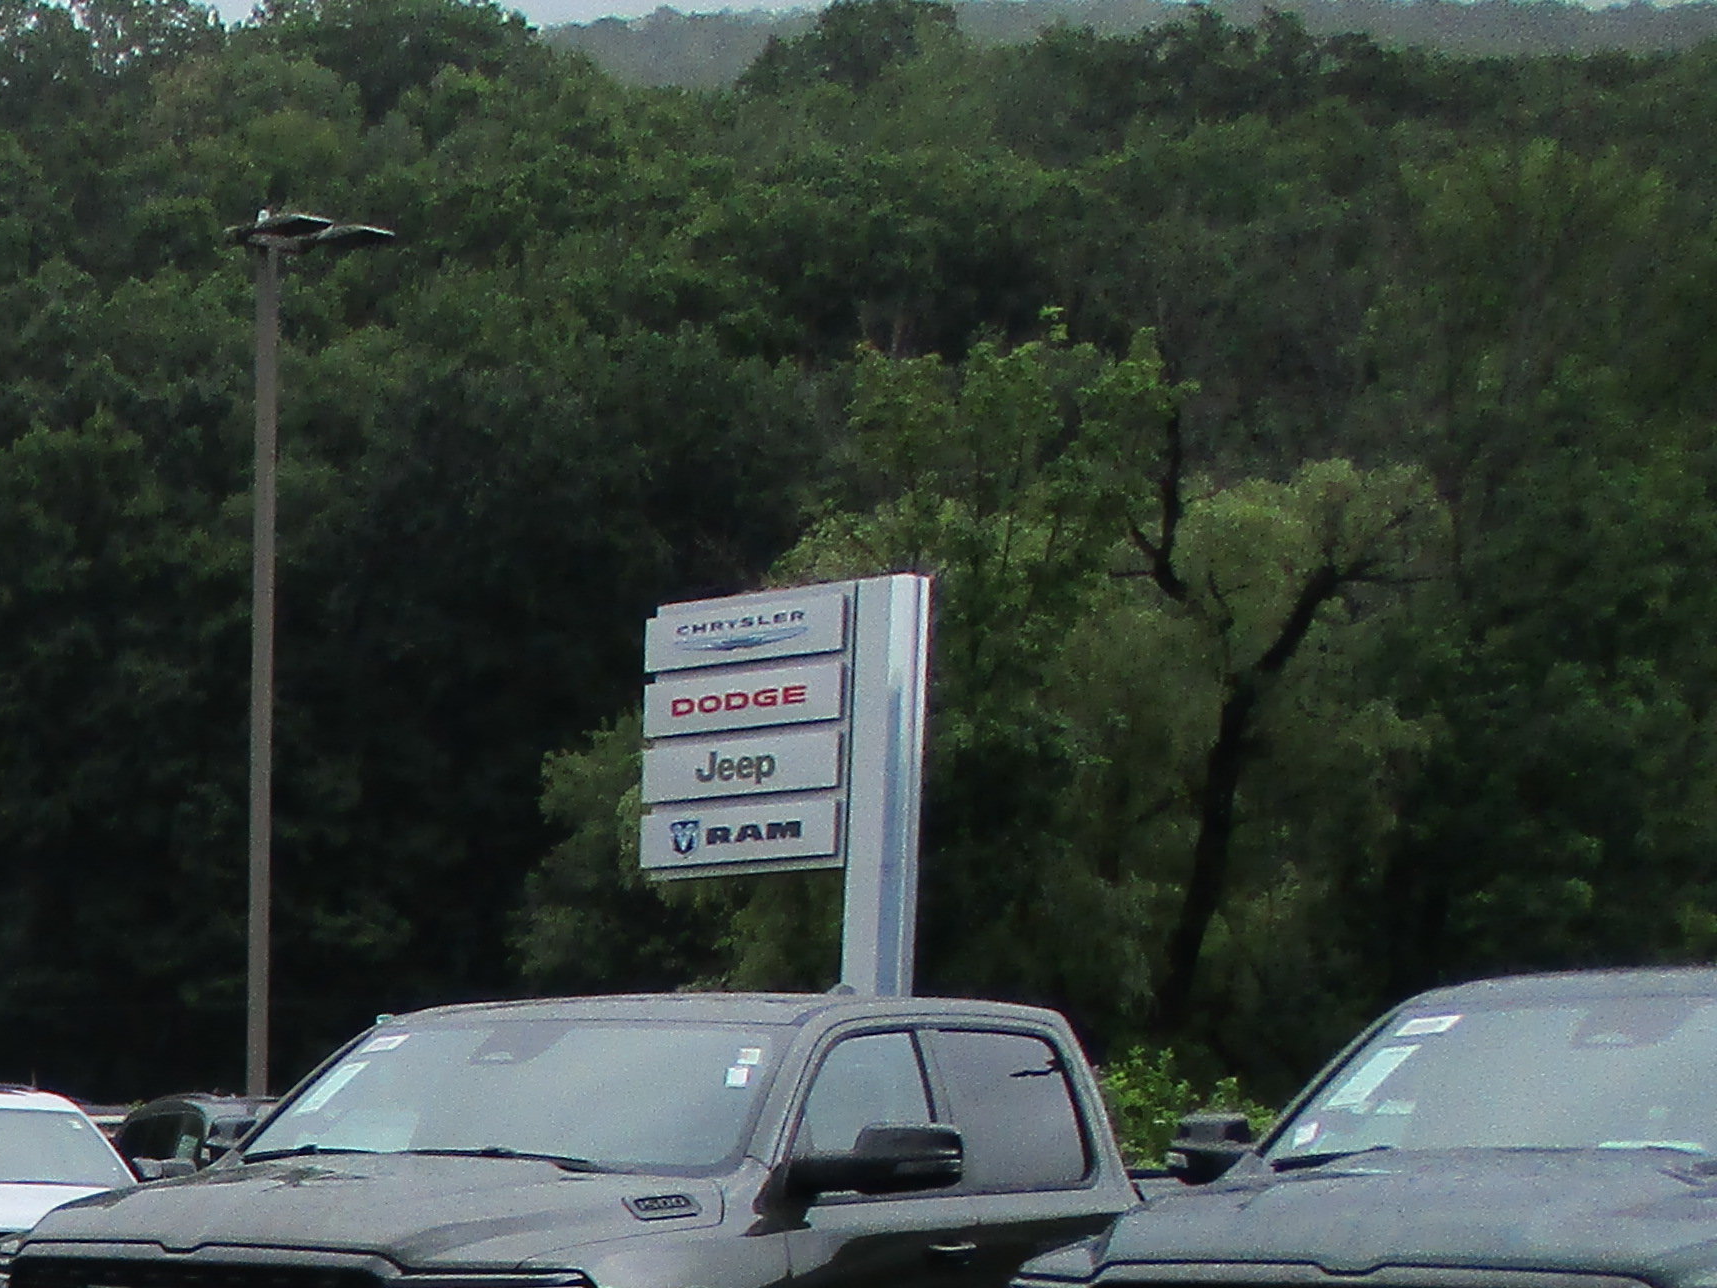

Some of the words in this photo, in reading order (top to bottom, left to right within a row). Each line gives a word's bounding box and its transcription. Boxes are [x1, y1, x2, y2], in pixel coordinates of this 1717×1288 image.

[676, 609, 806, 636] CHRYSLER
[670, 684, 808, 718] DODGE
[694, 751, 776, 784] Jeep
[705, 819, 803, 846] RAM
